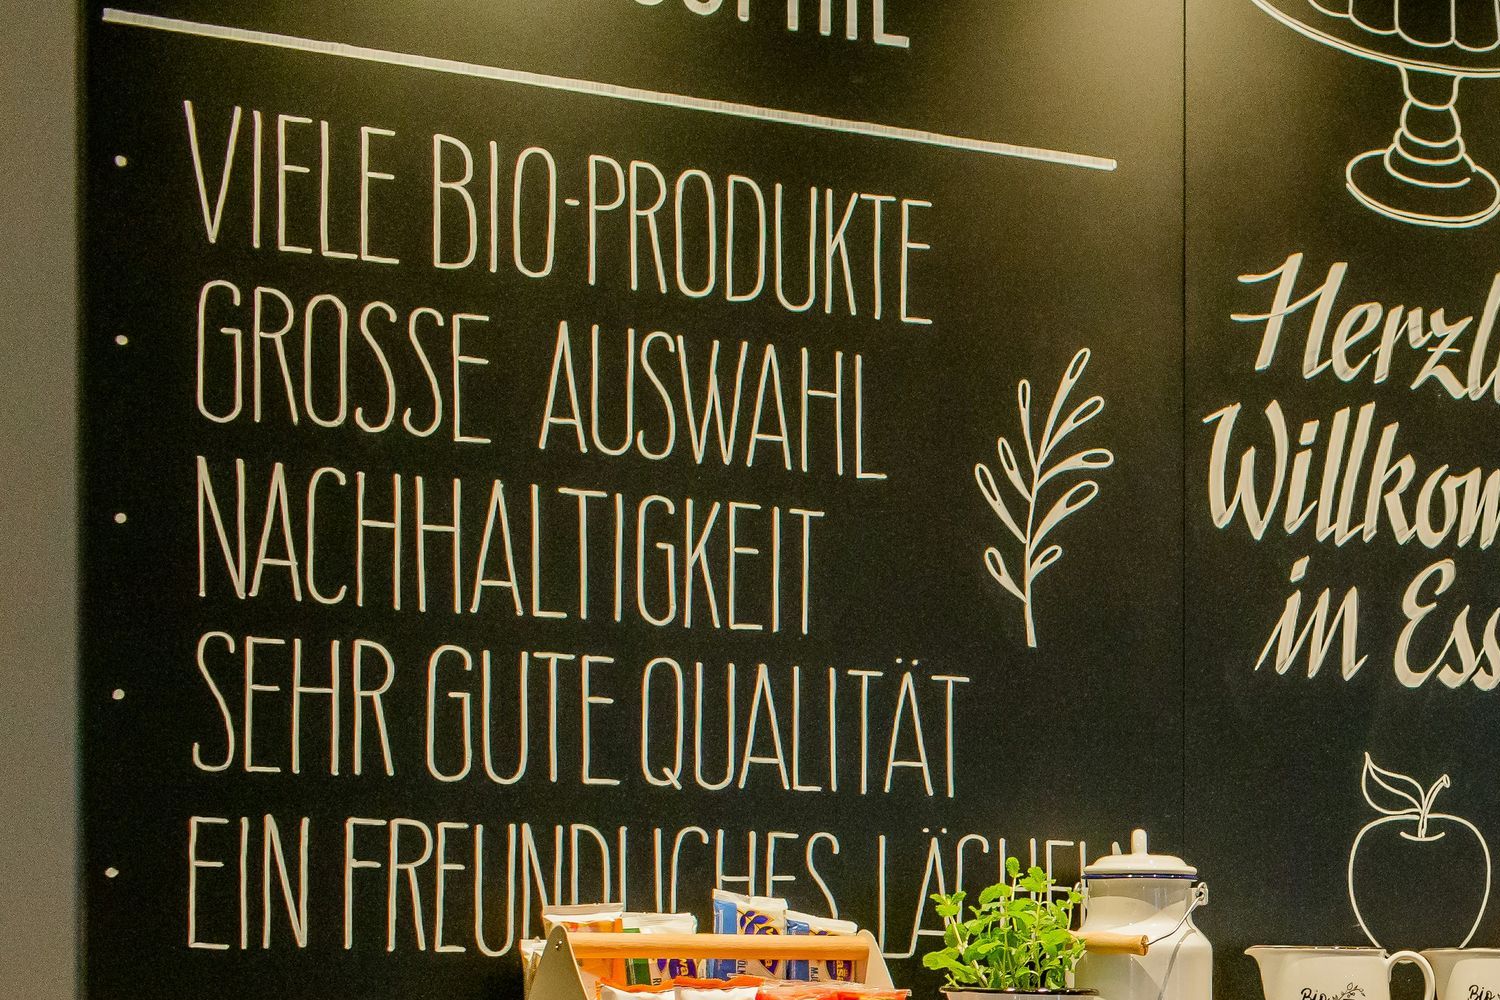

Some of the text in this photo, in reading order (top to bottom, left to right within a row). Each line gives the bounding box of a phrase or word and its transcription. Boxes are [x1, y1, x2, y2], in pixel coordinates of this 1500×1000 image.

[183, 99, 934, 326] VIELE BIO-PRODUKTE
[196, 278, 889, 481] GROSSE AUSWAHL
[195, 454, 826, 636] NACHHALTIGKEIT
[1253, 553, 1370, 683] in
[191, 630, 971, 800] SEHR GUTE QUALITÄT
[187, 813, 311, 951] EIN
[877, 826, 1122, 959] LÄCHEL
